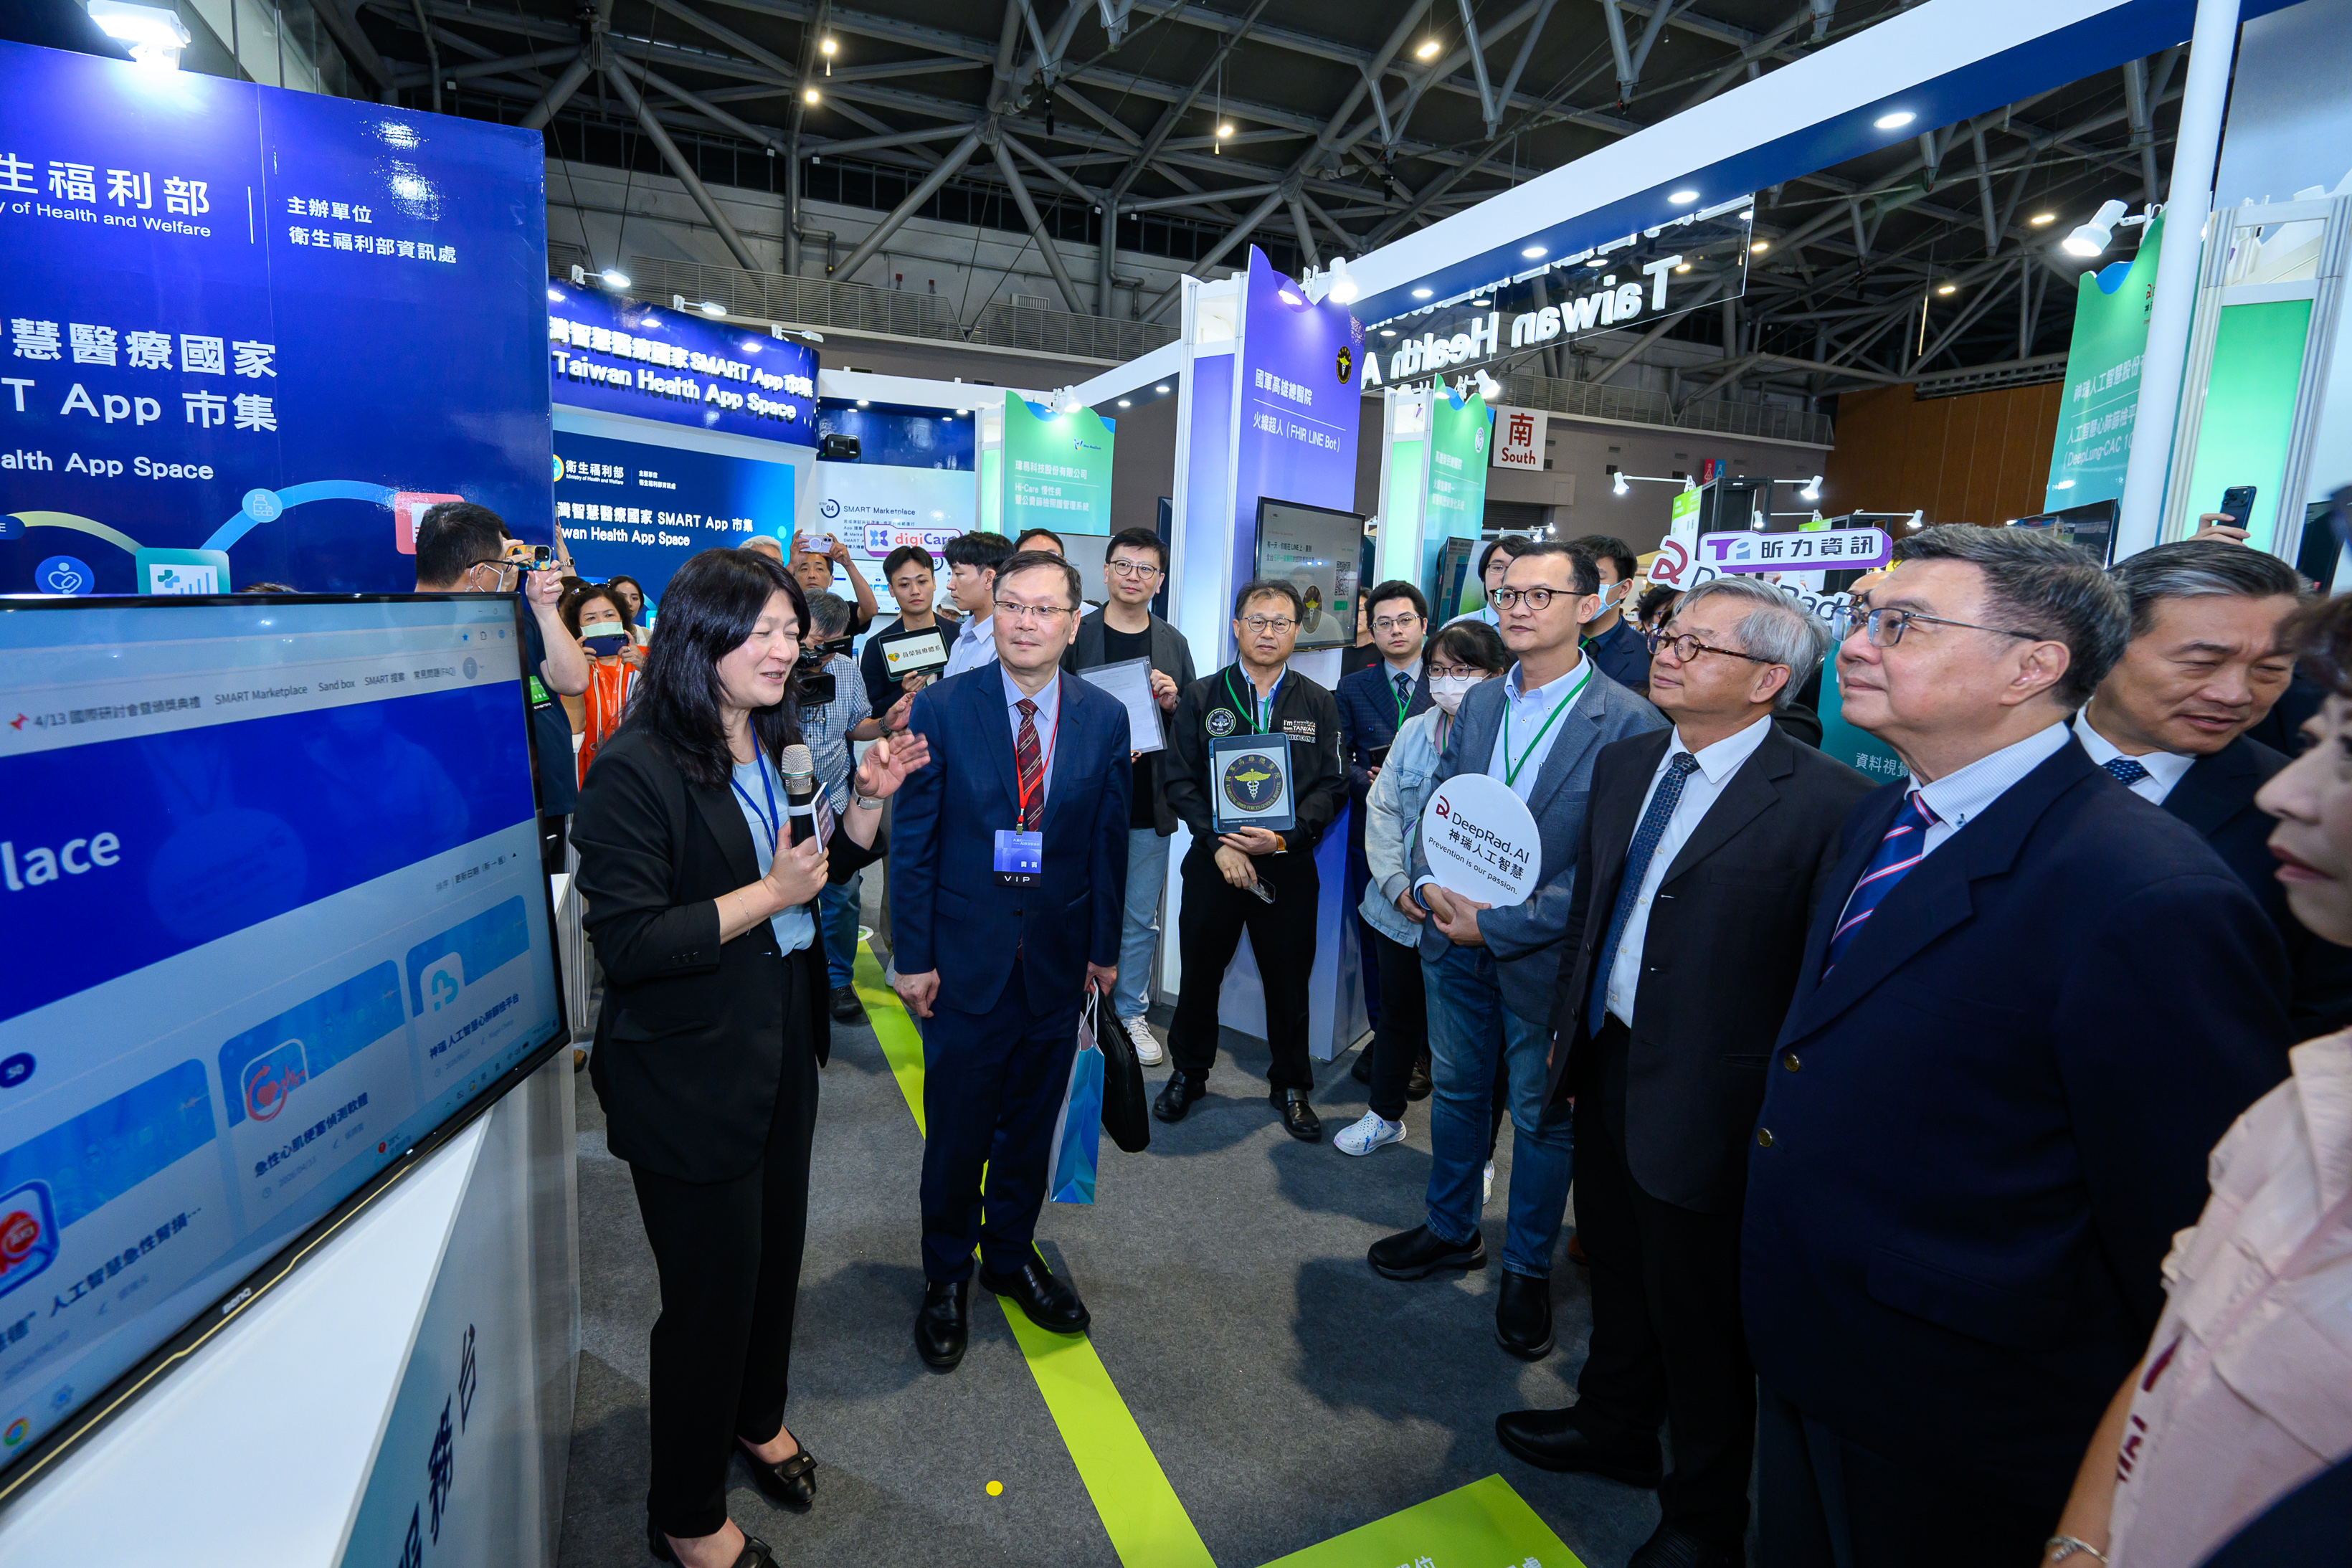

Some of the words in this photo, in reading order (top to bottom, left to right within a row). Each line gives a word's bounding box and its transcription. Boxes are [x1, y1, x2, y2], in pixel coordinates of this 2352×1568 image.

[0, 152, 210, 217] 生福利部
[11, 201, 31, 214] of
[37, 203, 98, 223] Health
[103, 214, 137, 228] and
[142, 216, 212, 237] Welfare
[287, 196, 373, 224] 主辦單位
[288, 225, 457, 264] 衛生福利部資訊處
[11, 318, 278, 379] 慧醫療國家
[552, 350, 632, 386] Taiwan
[637, 369, 701, 399] Health
[704, 384, 744, 409] App
[746, 393, 797, 419] Space
[689, 351, 751, 381] SMART
[751, 367, 784, 391] App
[782, 372, 813, 398] 市集
[1255, 368, 1313, 407] 國軍高雄總醫院
[60, 383, 161, 426] App
[182, 389, 278, 432] 市集
[1253, 411, 1284, 437] 火線超人
[1309, 429, 1324, 447] LINE
[1509, 412, 1535, 447] 南
[65, 452, 123, 477] App
[133, 456, 214, 480] Space
[565, 460, 625, 479] 衛生福利部
[1501, 447, 1536, 465] South
[1015, 482, 1039, 494] Hi-Care
[1041, 485, 1062, 497] 慢性病
[557, 501, 653, 525] 灣智慧醫療國家
[657, 511, 701, 528] SMART
[705, 515, 729, 532] App
[732, 517, 754, 533] 市集
[873, 507, 916, 515] Marketplace
[591, 526, 628, 543] Health
[631, 530, 655, 546] App
[658, 531, 691, 547] Space
[1760, 536, 1874, 559] 昕力資訊
[214, 690, 250, 705] SMART
[252, 685, 308, 701] Marketplace
[318, 680, 339, 692] Sand
[341, 680, 356, 690] box
[364, 675, 389, 686] SMART
[33, 712, 67, 729] 4/13
[1855, 752, 1910, 778] 資料視覺
[1, 831, 120, 891] lace
[1448, 828, 1524, 880] 神瑞人工智慧
[1474, 863, 1486, 875] our
[1486, 873, 1518, 895] passion.
[255, 1091, 369, 1178] 急性心肌梗塞偵測軟體
